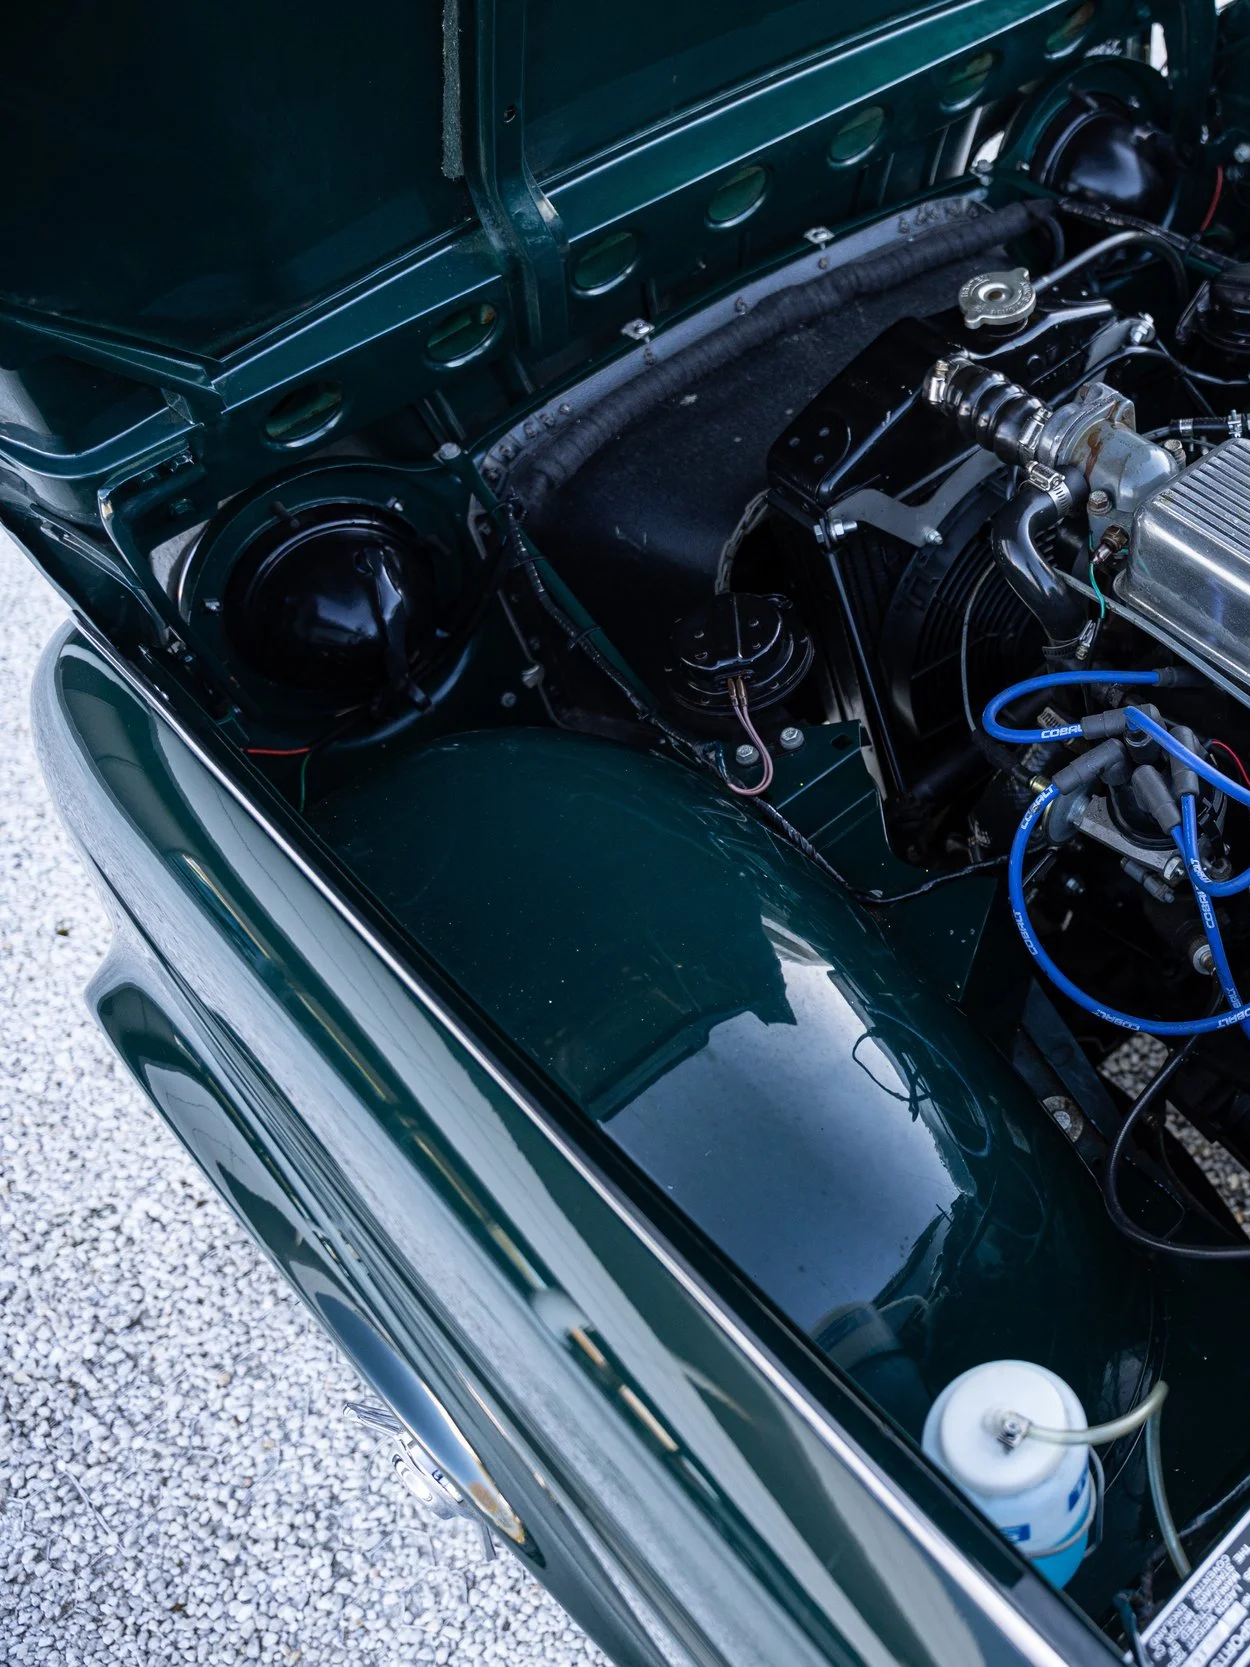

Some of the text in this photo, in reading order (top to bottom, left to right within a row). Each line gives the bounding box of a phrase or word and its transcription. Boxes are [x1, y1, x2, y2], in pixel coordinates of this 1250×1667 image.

[1041, 725, 1082, 739] COBAL
[1012, 909, 1038, 956] COBALT
[1225, 987, 1242, 1009] BALT
[1091, 1008, 1140, 1031] COBALT
[1193, 1563, 1236, 1610] STANDARD
[1213, 1583, 1243, 1615] LADEN
[1181, 1571, 1241, 1640] MANUFACTURED
[1148, 1602, 1188, 1647] ENGLAND
[1164, 1610, 1195, 1644] MOTOR
[1187, 1614, 1218, 1650] WEIGHT
